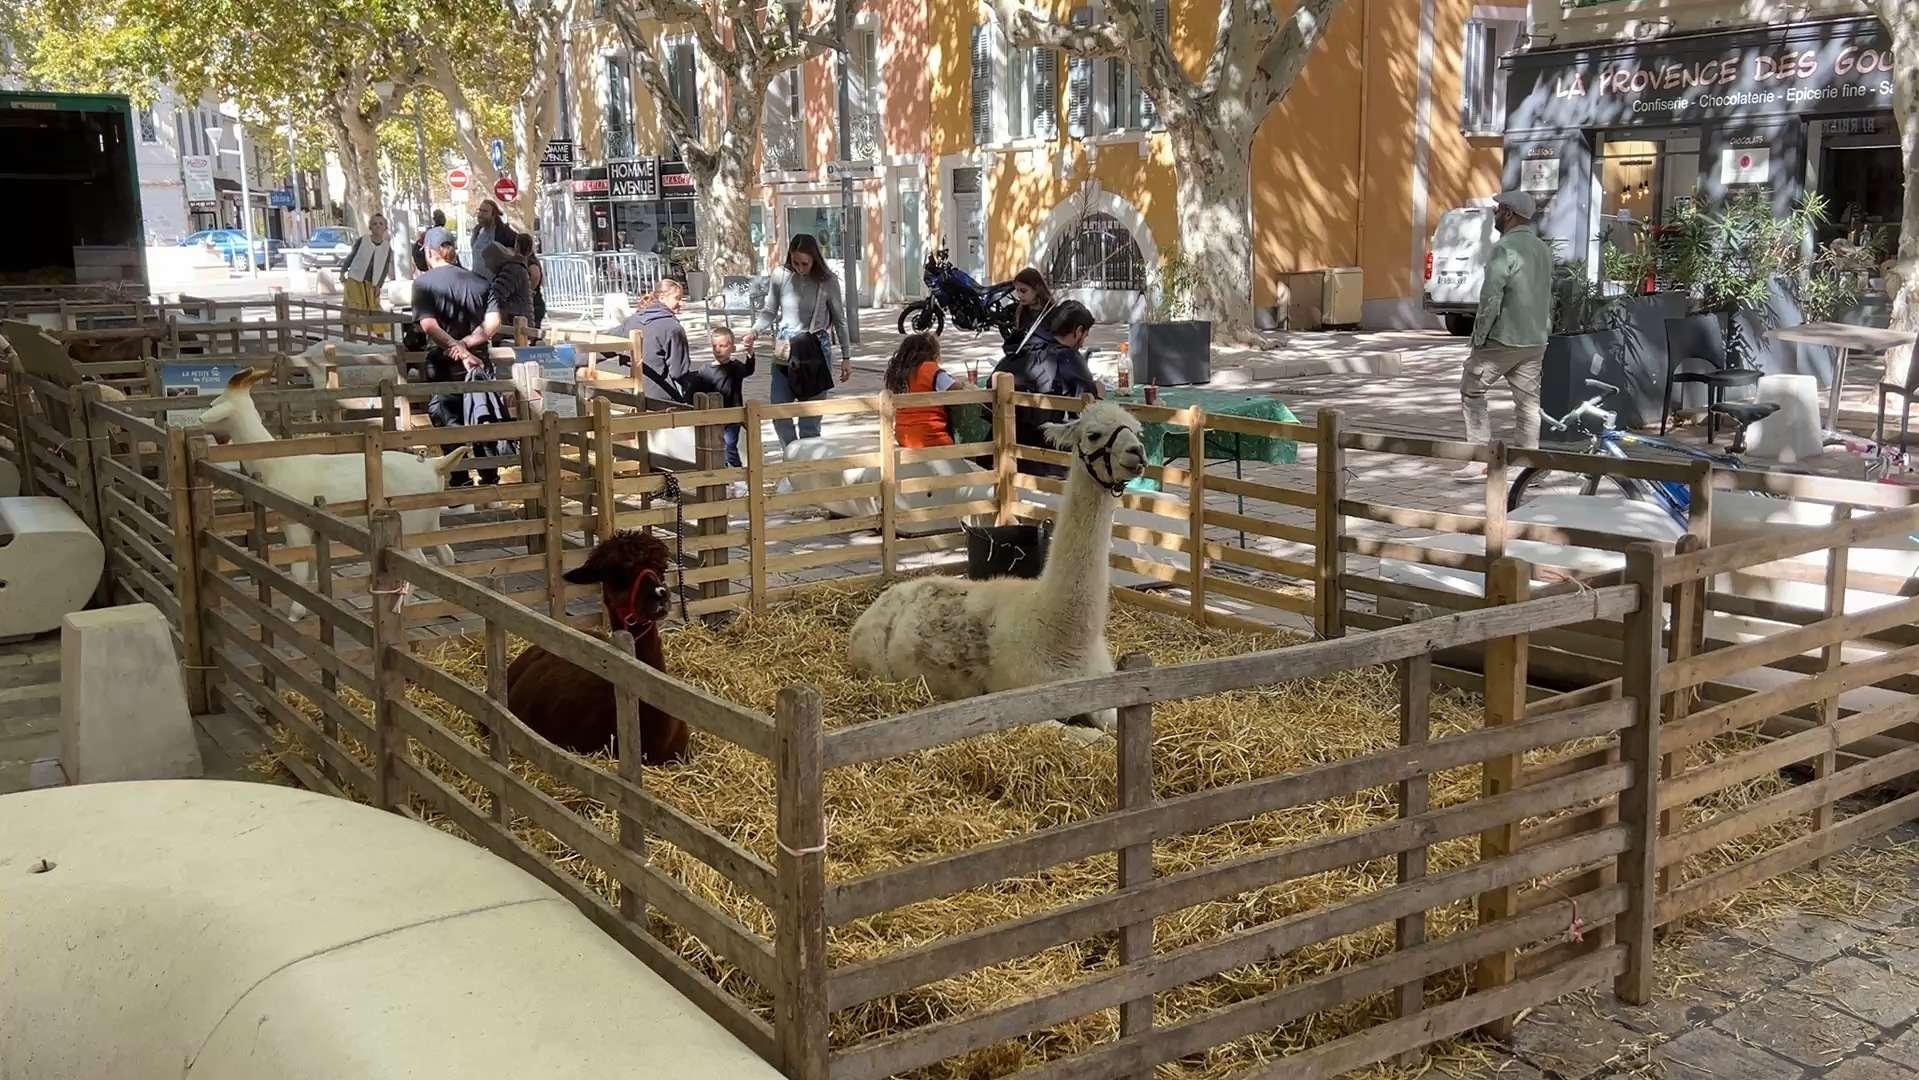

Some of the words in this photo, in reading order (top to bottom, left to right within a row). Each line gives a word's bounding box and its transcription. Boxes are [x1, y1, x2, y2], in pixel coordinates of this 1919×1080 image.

[1556, 73, 1586, 100] LA
[1600, 57, 1740, 97] PROVENCE
[1754, 50, 1818, 82] DES
[1632, 96, 1689, 113] Confiserie
[1699, 90, 1775, 108] Chocolaterie
[1786, 85, 1838, 104] Epicerie
[1842, 83, 1866, 97] fine
[611, 162, 654, 178] HOMME
[612, 180, 655, 195] AVENUE
